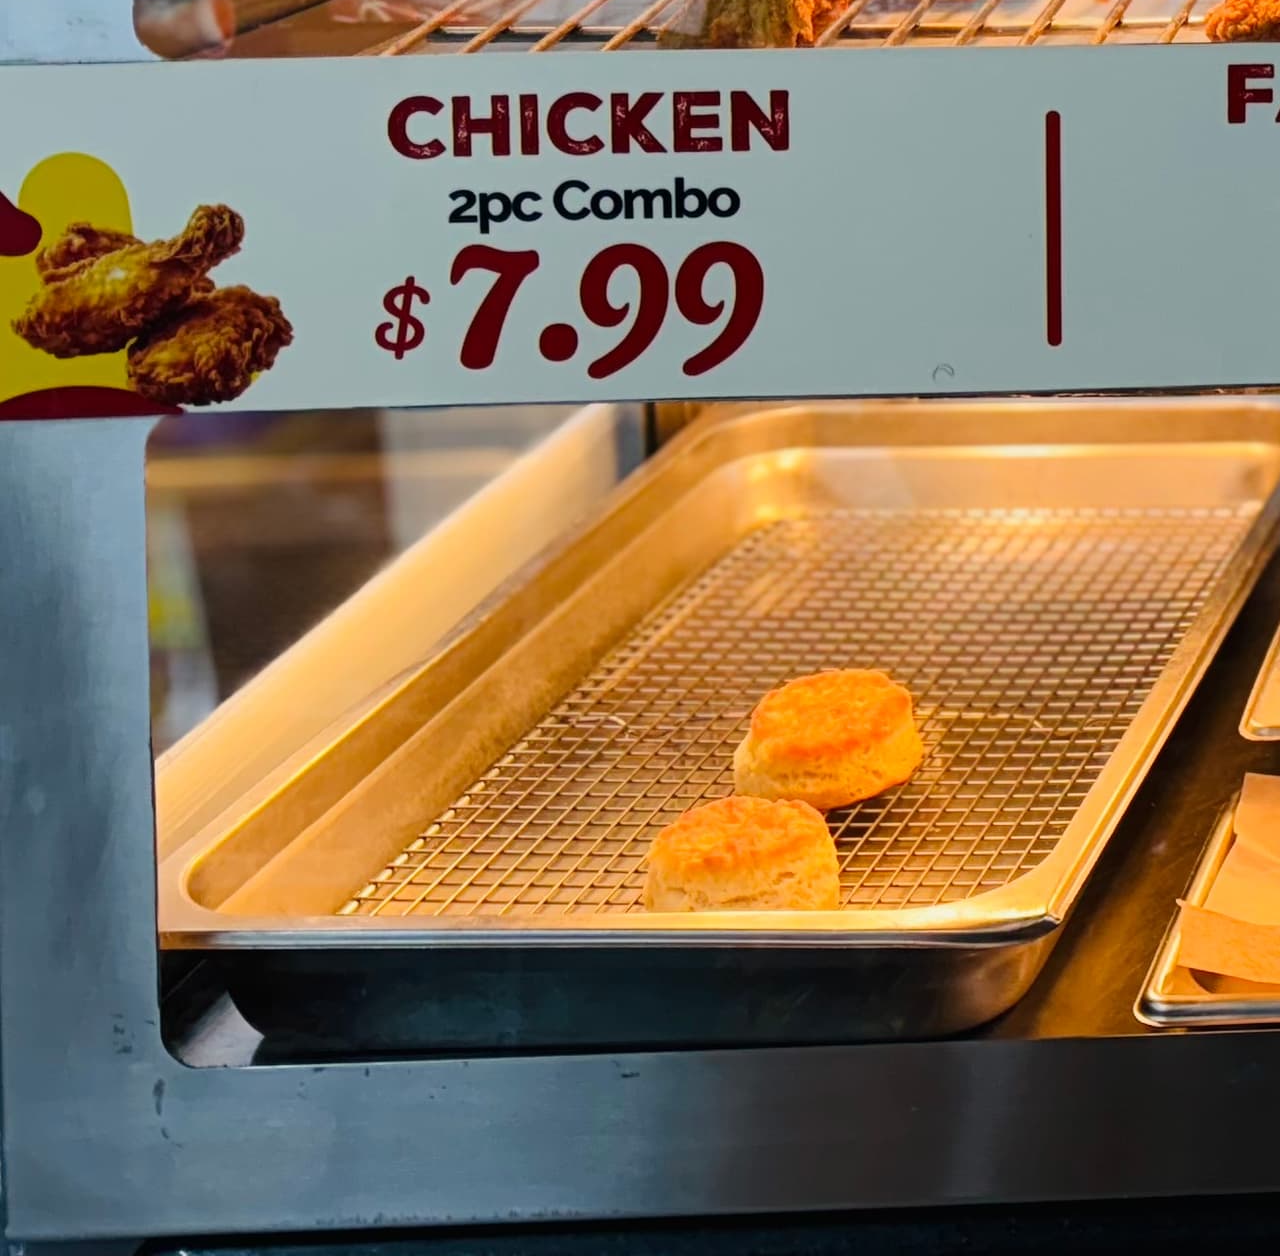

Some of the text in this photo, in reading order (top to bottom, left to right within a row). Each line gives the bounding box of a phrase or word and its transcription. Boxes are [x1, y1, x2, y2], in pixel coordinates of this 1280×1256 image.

[387, 89, 790, 161] CHICKEN
[448, 176, 741, 235] 2pc Combo
